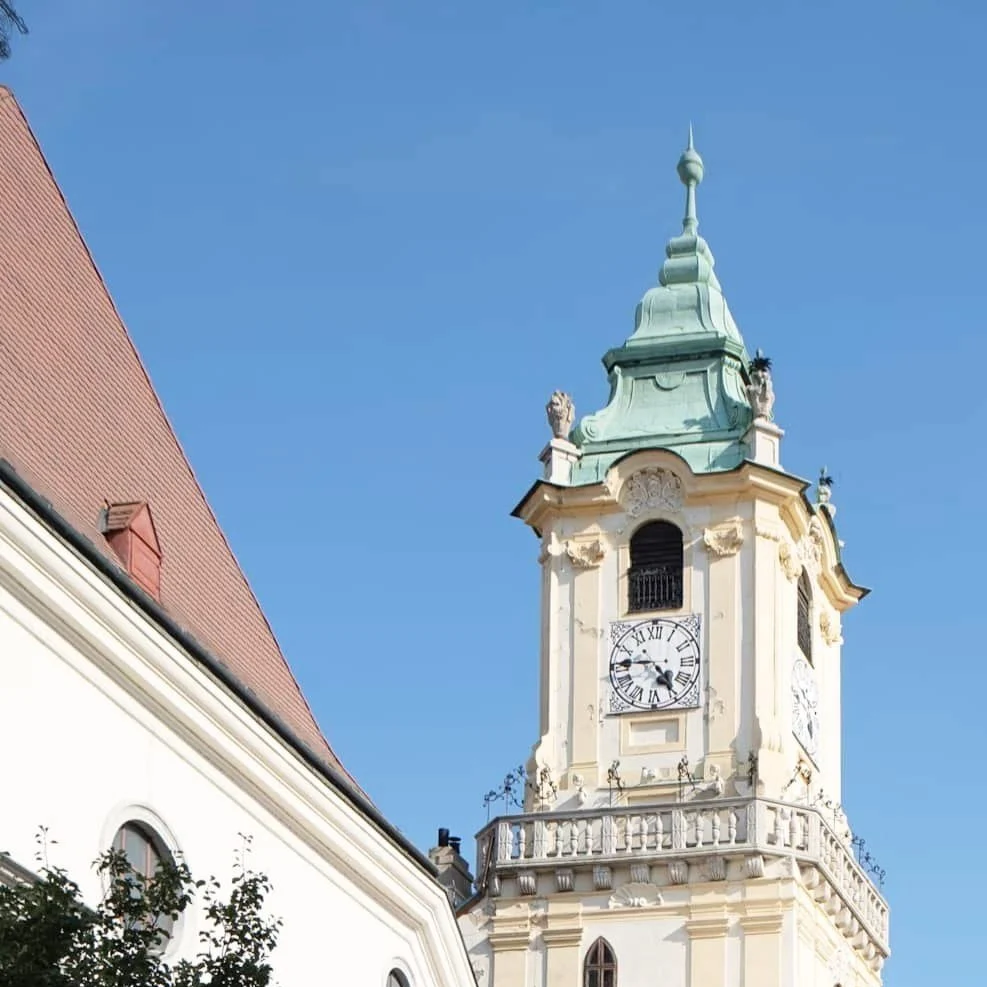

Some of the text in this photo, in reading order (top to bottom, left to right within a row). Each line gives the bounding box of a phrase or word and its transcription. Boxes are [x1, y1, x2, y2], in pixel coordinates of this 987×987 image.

[631, 630, 645, 646] XI
[648, 626, 662, 640] XII
[667, 629, 675, 641] I
[620, 645, 633, 656] X
[680, 656, 694, 667] III
[674, 671, 691, 686] IIII
[648, 689, 660, 703] VI
